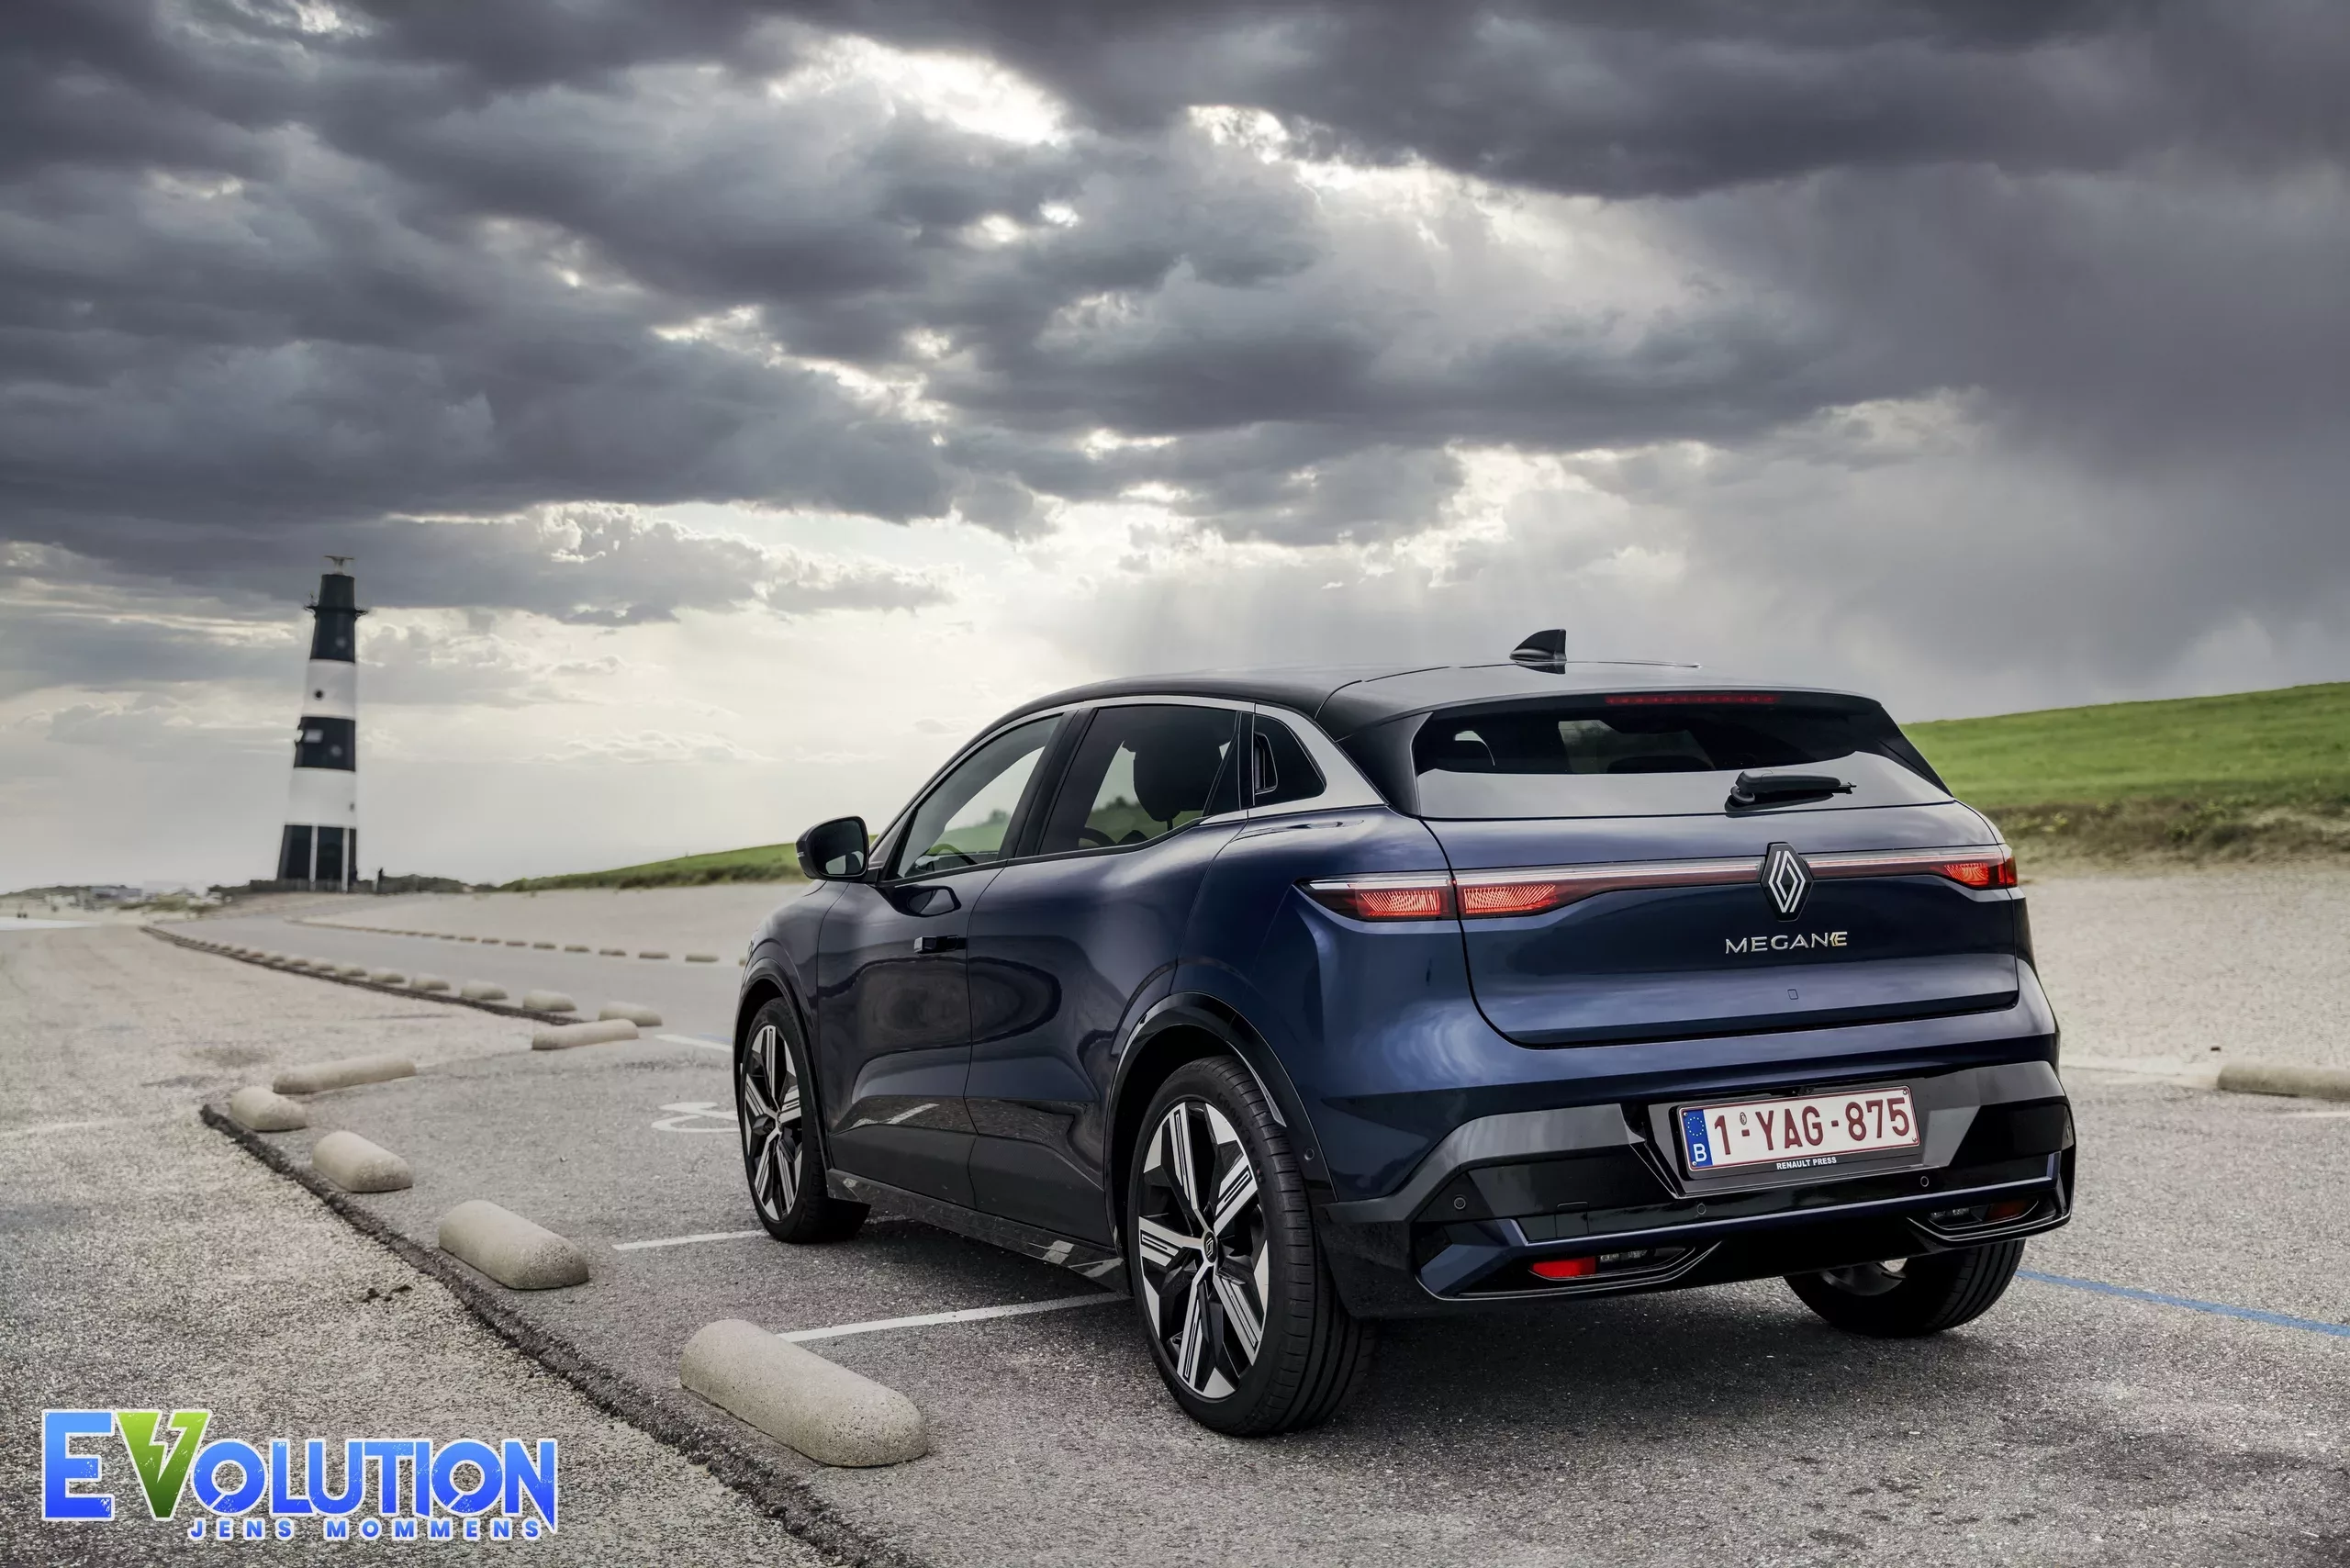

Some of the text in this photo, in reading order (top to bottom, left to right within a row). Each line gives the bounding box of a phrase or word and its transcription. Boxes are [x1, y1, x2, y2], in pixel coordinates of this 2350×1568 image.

[1725, 931, 1848, 954] MEGANE
[1714, 1097, 1910, 1155] 1-YAG-875
[1693, 1143, 1707, 1162] B
[1775, 1156, 1837, 1170] RENAULT PRESS
